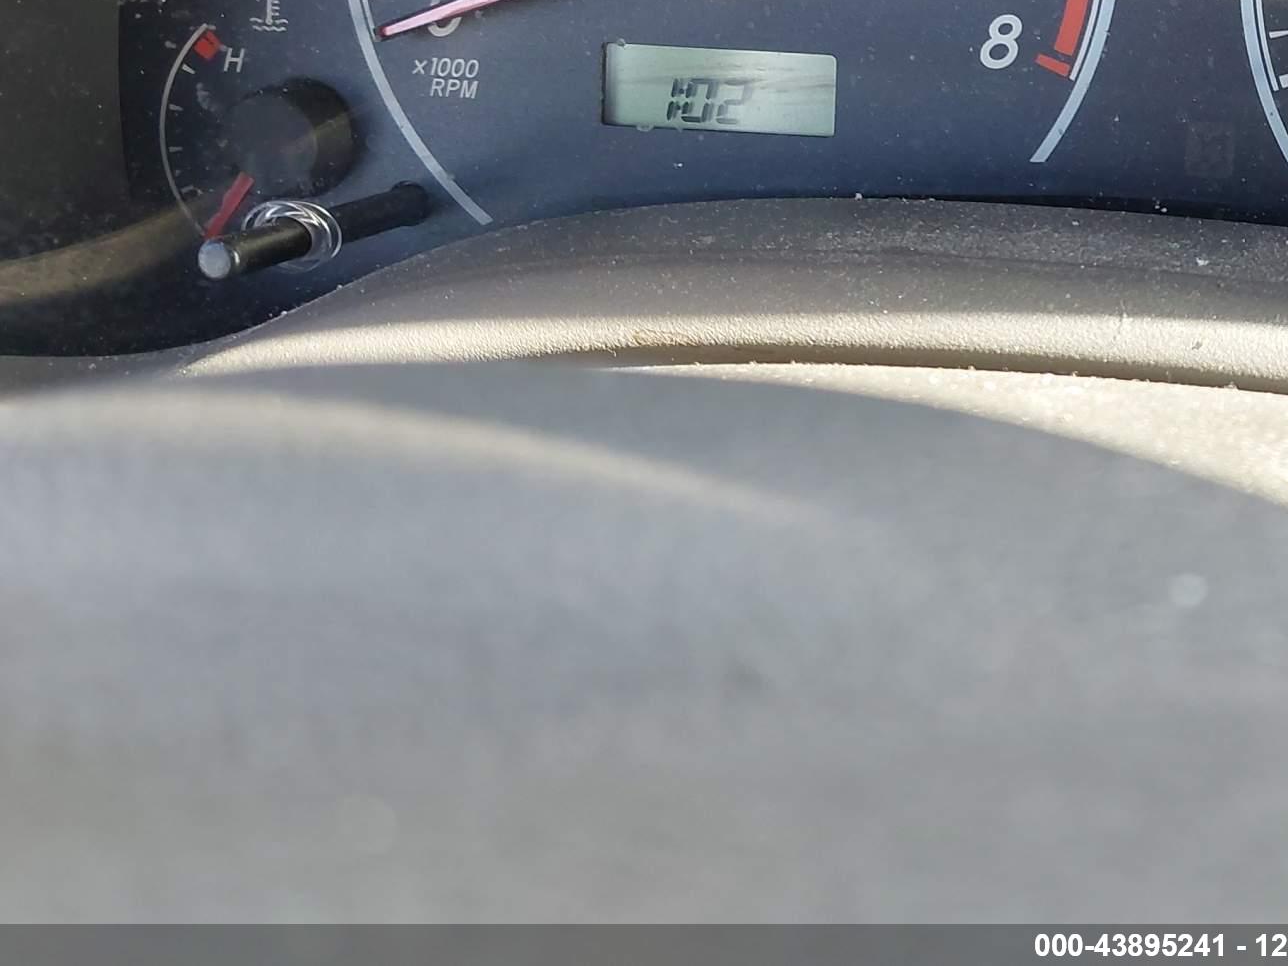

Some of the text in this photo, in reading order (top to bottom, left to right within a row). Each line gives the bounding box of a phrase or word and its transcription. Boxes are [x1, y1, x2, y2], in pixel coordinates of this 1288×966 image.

[980, 15, 1021, 68] 8
[223, 48, 245, 72] H
[430, 79, 478, 99] RPM
